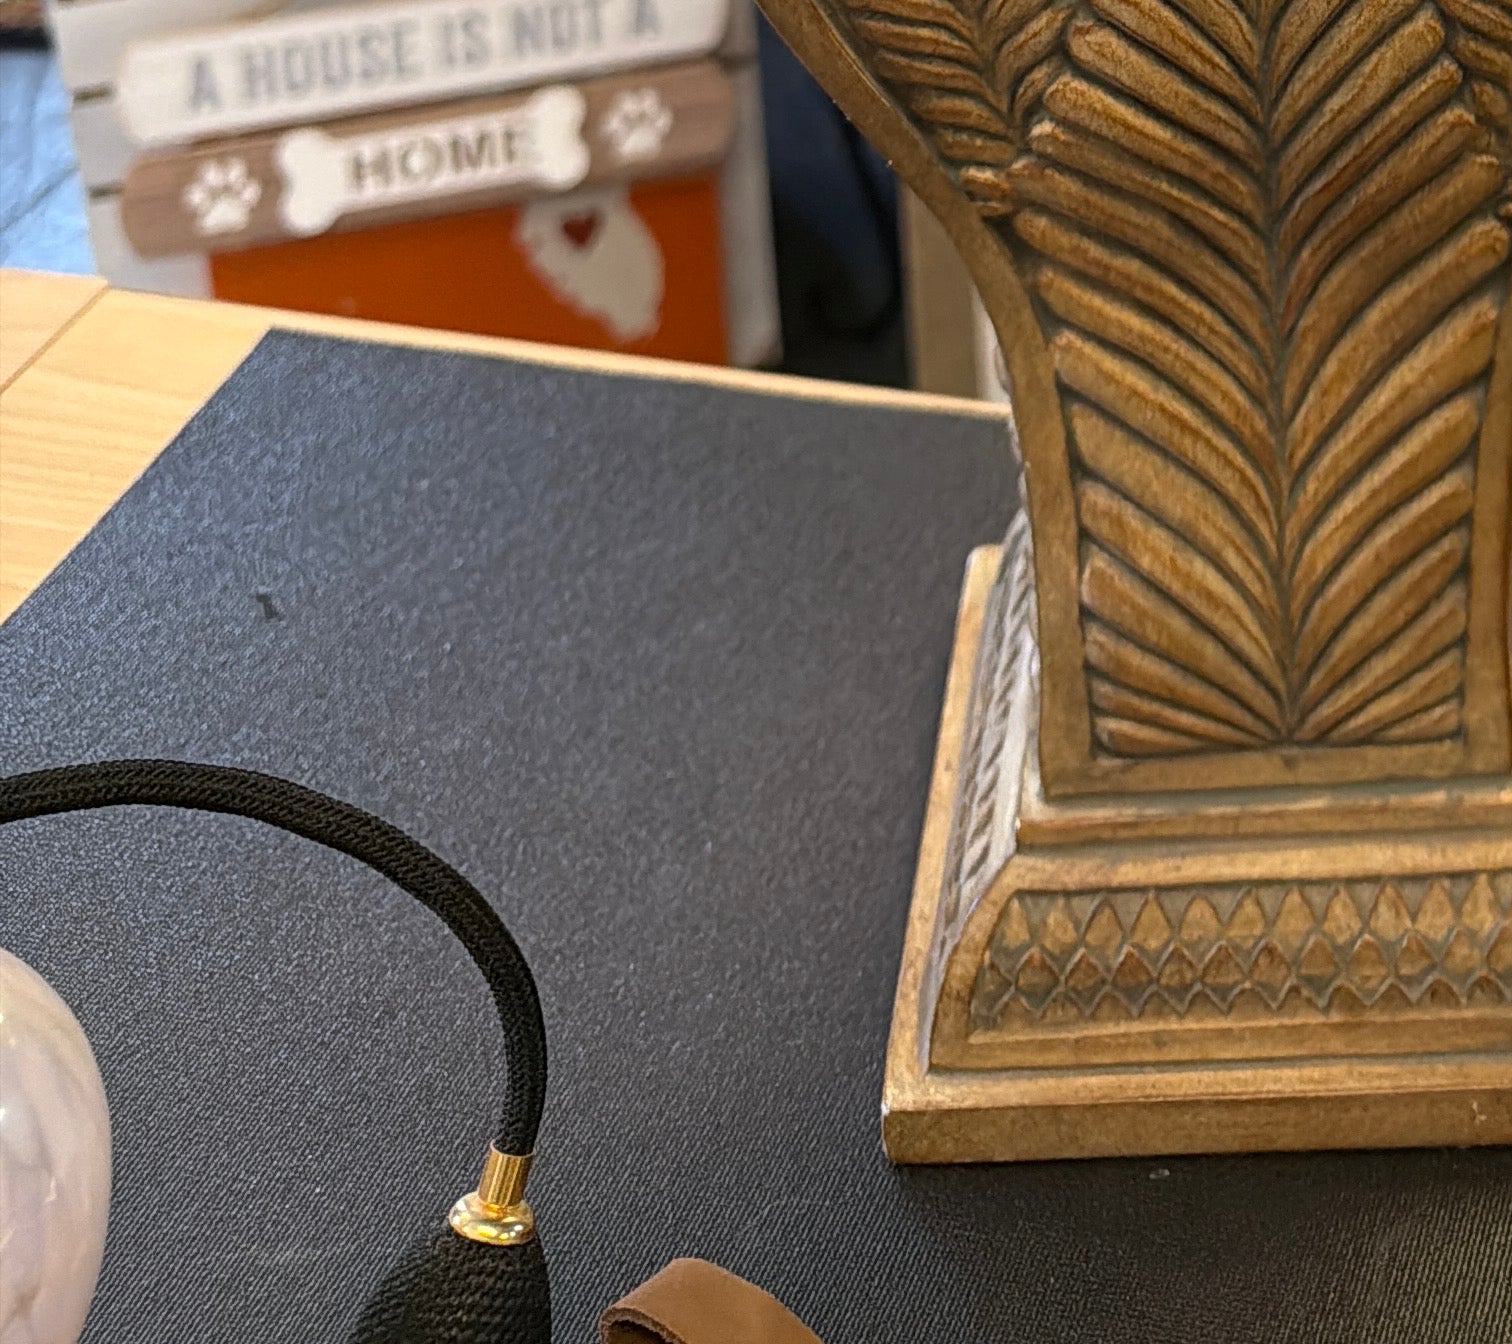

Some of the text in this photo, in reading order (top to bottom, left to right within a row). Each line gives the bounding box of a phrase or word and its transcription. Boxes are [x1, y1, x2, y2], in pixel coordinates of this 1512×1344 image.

[187, 54, 222, 111] A
[241, 18, 424, 98] HOUSE
[440, 8, 492, 68] IS
[350, 120, 536, 192] HOME
